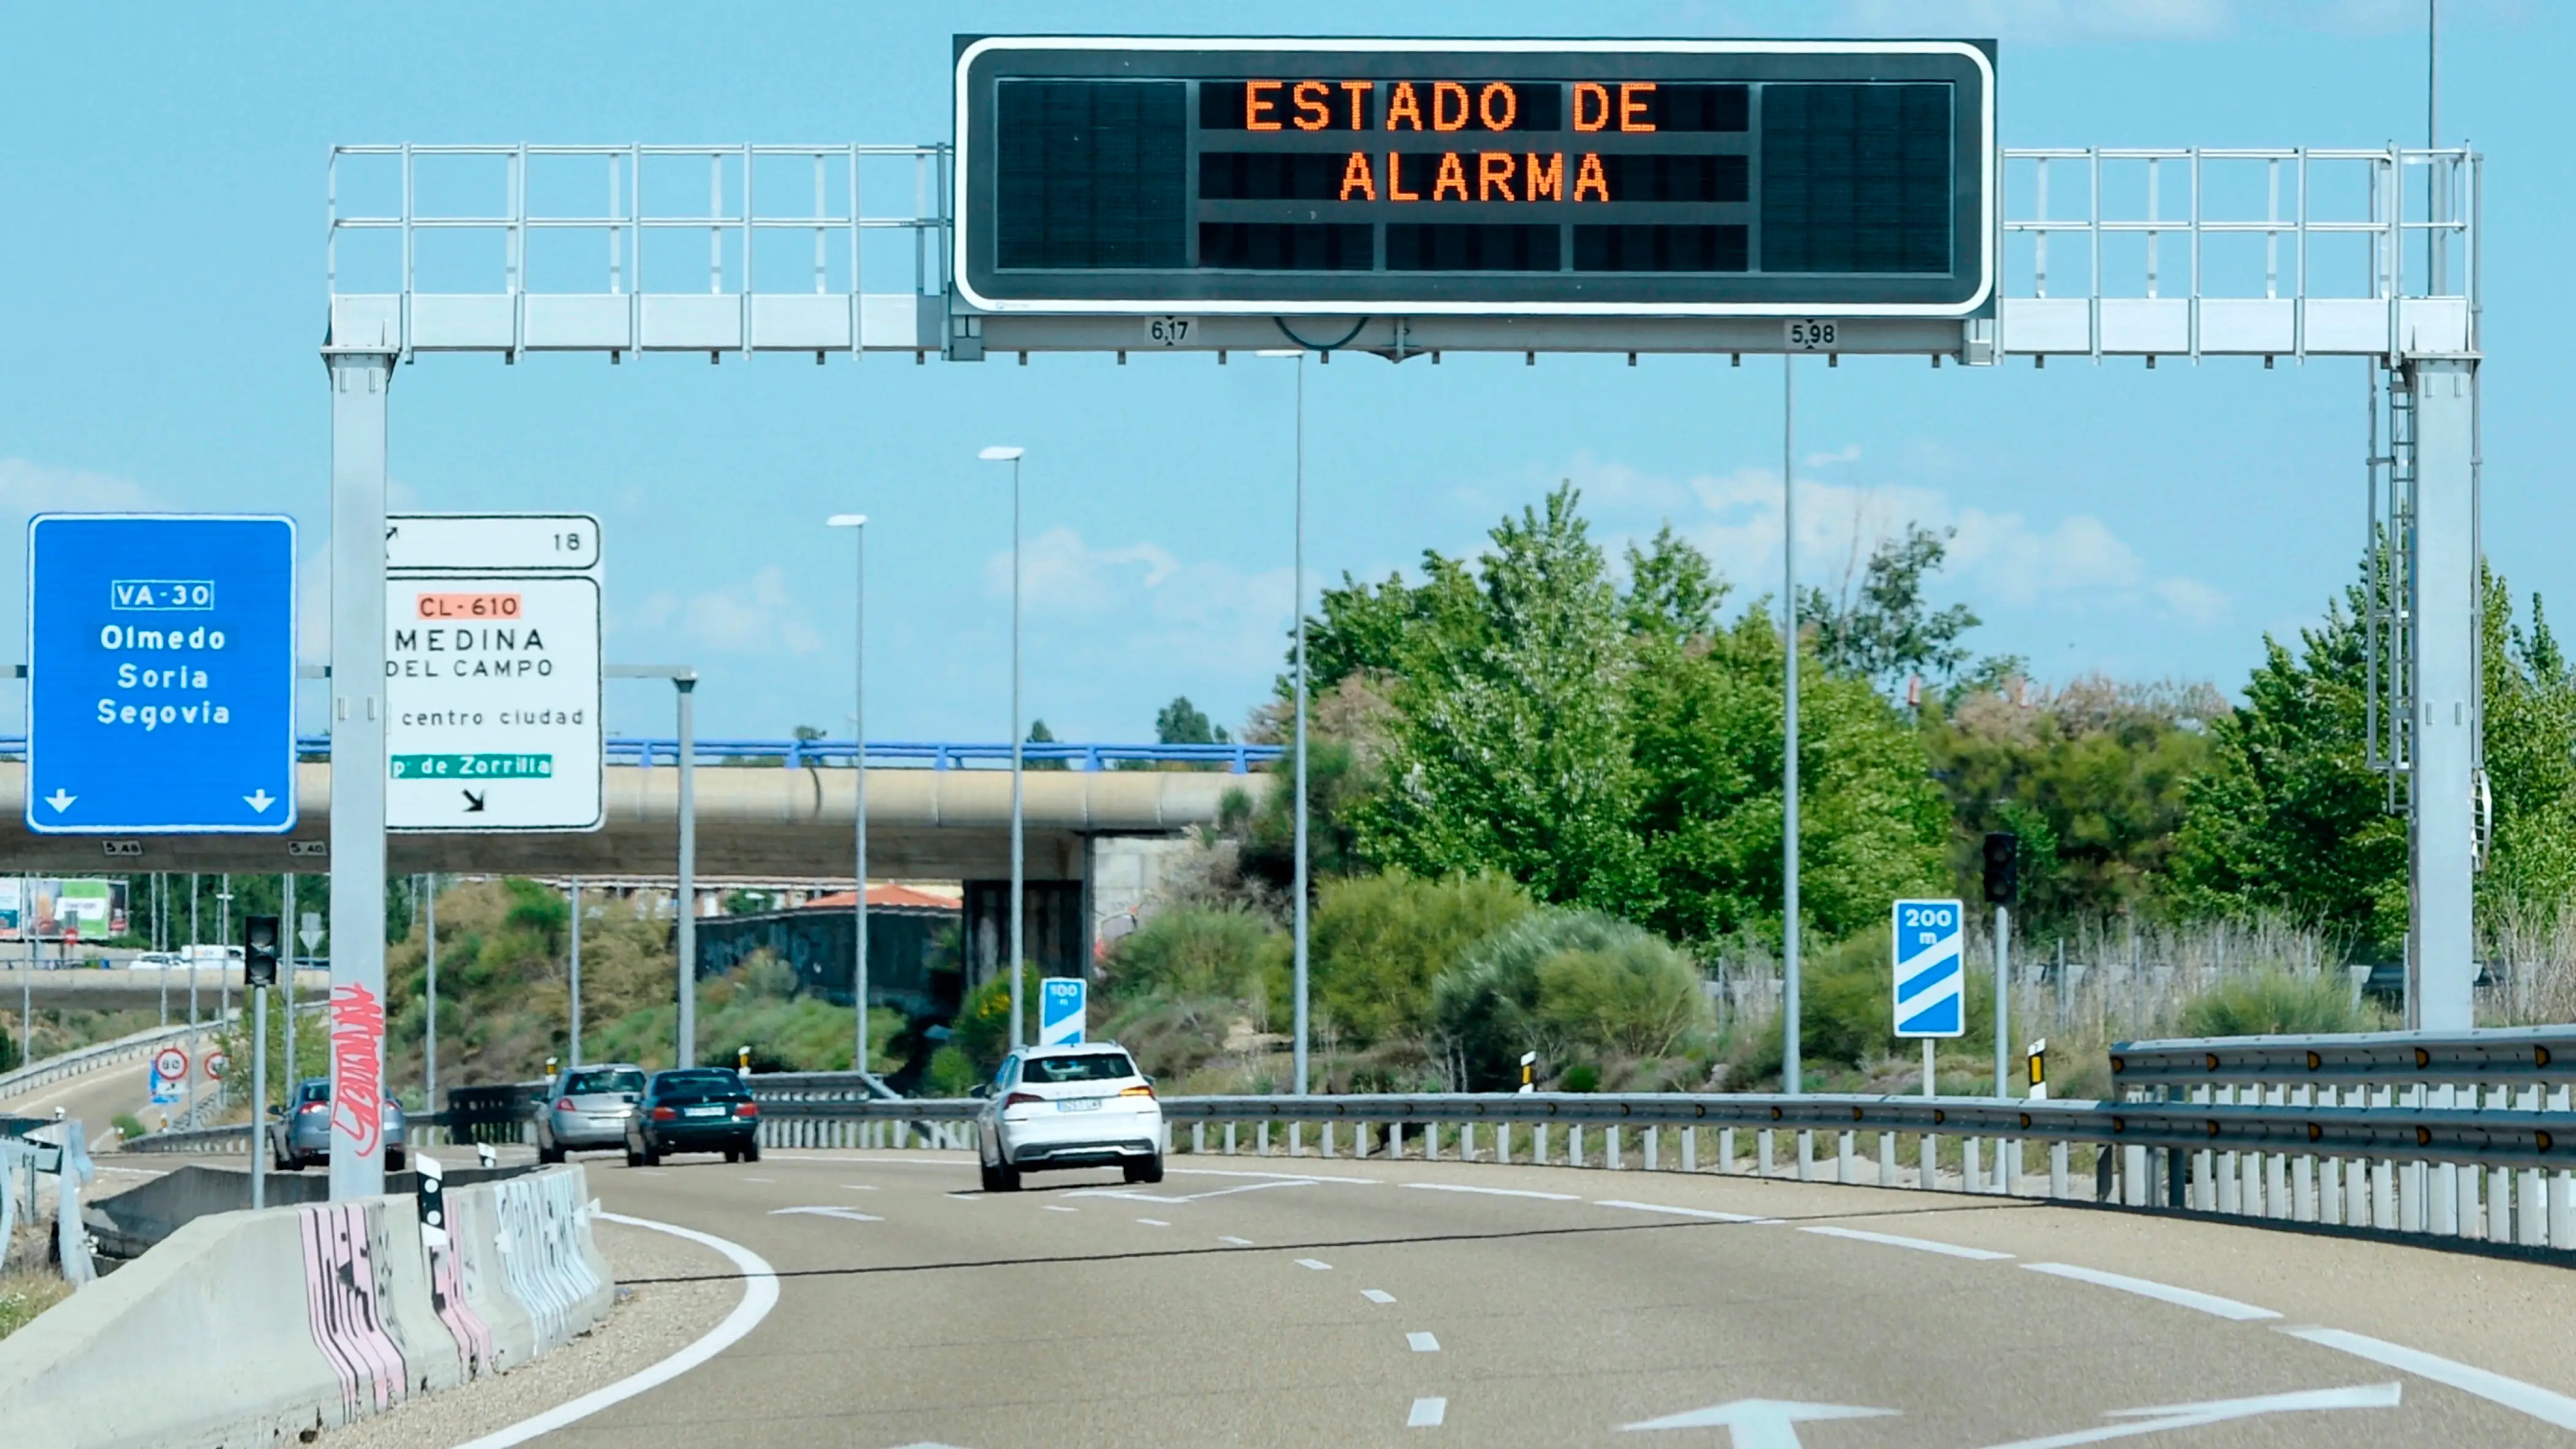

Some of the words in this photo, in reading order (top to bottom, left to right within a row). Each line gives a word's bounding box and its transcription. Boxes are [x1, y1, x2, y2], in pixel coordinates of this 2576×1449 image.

[1246, 81, 1517, 132] ESTADO
[1573, 82, 1656, 133] DE
[1340, 152, 1609, 202] ALARMA
[1152, 321, 1188, 340] 6,17
[1792, 325, 1834, 344] 5,98
[555, 533, 580, 551] 18
[117, 585, 209, 605] VA-30
[420, 598, 517, 617] CL-610
[101, 625, 225, 650] Olmedo
[395, 629, 544, 651] MEDINA
[117, 663, 207, 688] Soria
[385, 659, 439, 677] DEL
[454, 659, 552, 677] CAMPO
[98, 699, 229, 731] Segovia
[402, 710, 482, 725] centro
[500, 709, 583, 725] ciudad
[421, 756, 448, 774] de
[459, 756, 550, 774] Zorrilla
[1905, 909, 1951, 927] 200
[1920, 932, 1936, 944] m
[1050, 984, 1078, 997] 100
